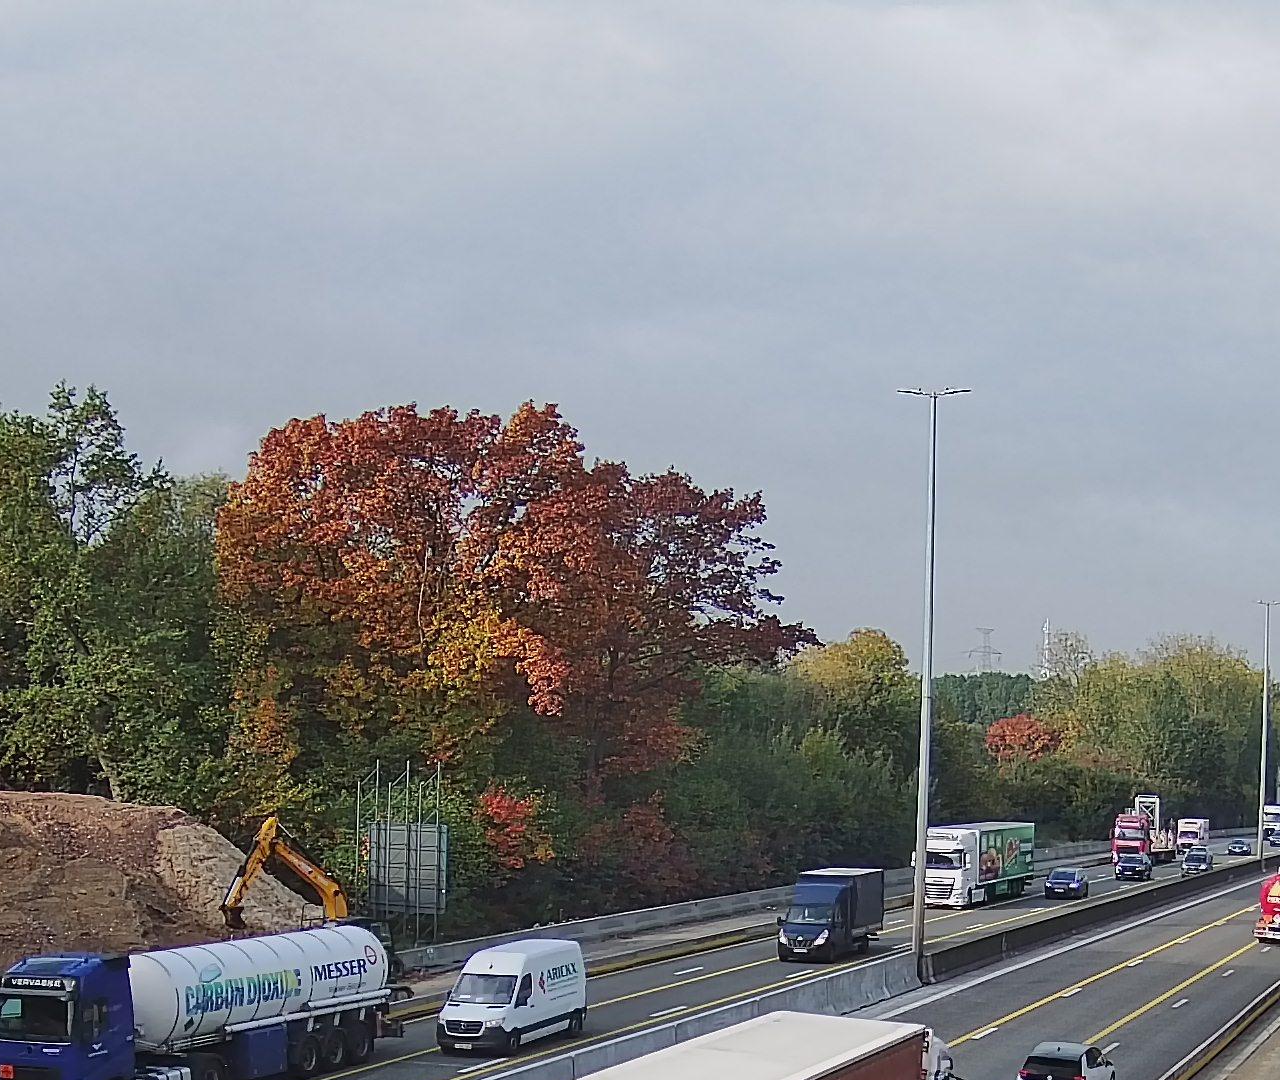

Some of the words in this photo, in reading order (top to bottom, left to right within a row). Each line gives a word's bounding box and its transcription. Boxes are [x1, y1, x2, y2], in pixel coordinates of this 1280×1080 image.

[313, 958, 368, 982] MESSER
[546, 962, 578, 982] ARICKX
[185, 976, 245, 1016] CARBON
